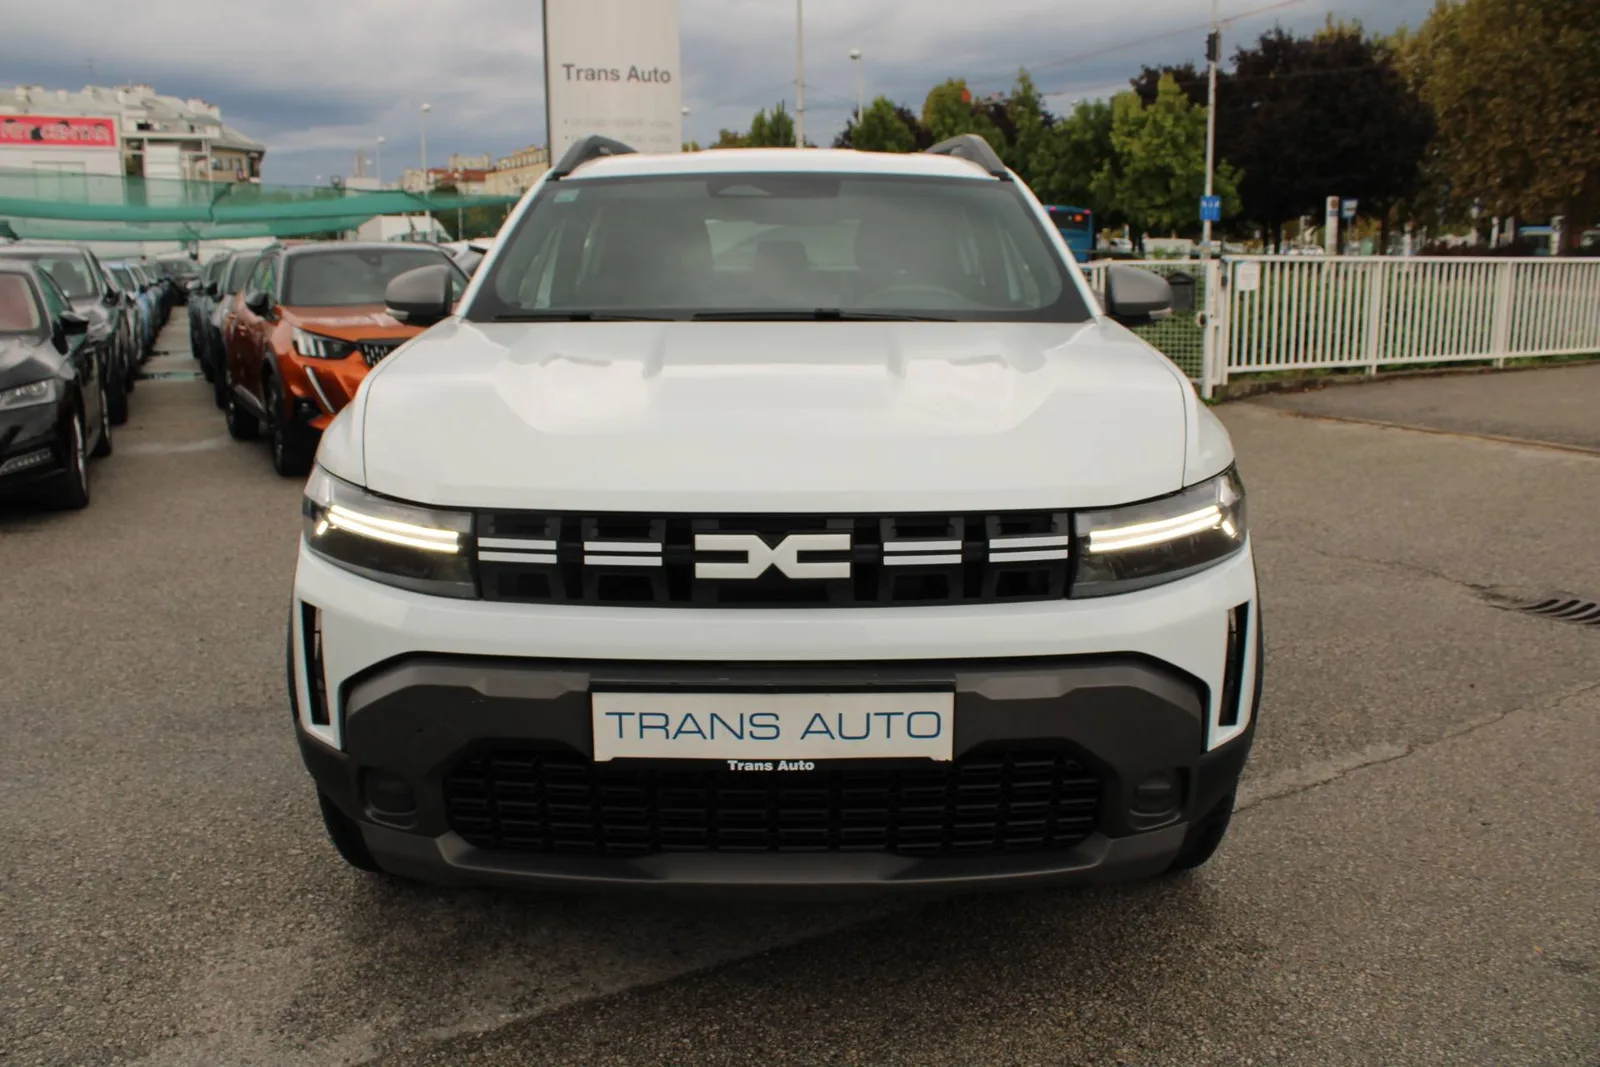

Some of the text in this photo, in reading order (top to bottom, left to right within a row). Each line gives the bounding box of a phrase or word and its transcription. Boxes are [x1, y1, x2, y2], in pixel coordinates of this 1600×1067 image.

[561, 63, 672, 84] Trans Auto
[605, 710, 943, 741] TRANS AUTO
[727, 759, 815, 771] Trans Auto
